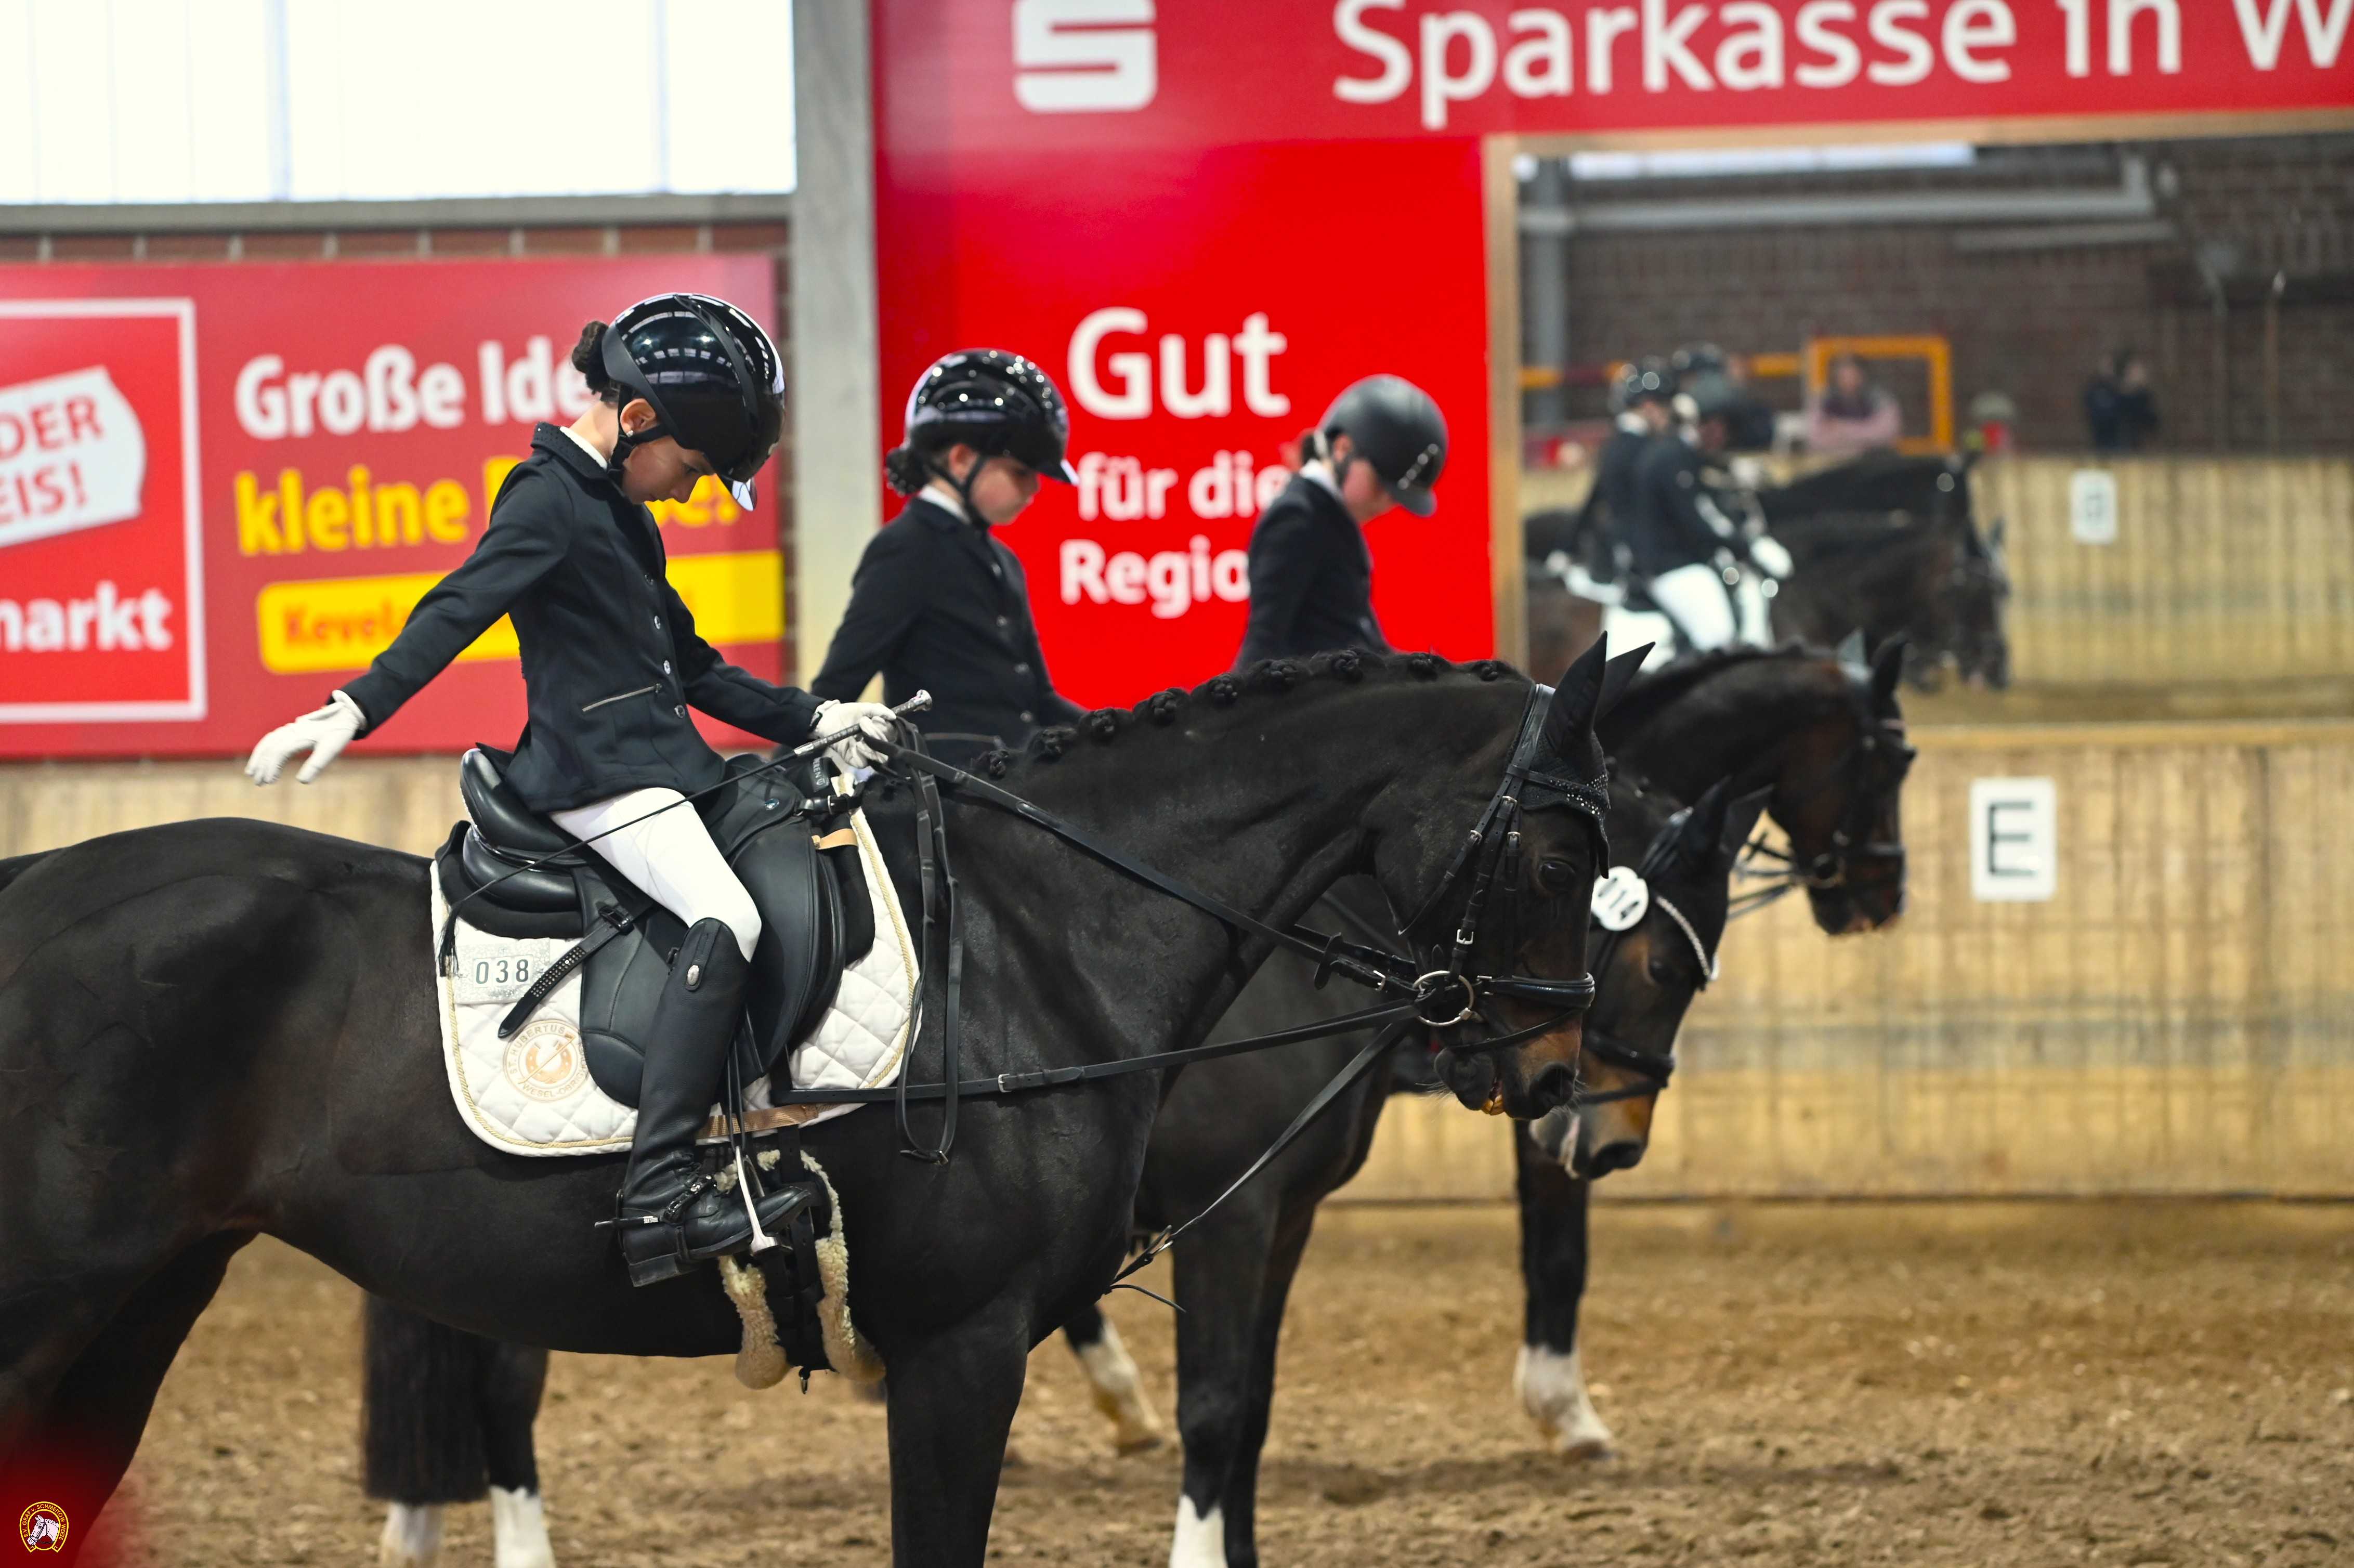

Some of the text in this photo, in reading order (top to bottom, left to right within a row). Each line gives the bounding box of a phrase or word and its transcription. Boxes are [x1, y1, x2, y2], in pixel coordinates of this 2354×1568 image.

[1332, 0, 2018, 130] Sparkasse
[2056, 0, 2182, 77] in
[233, 335, 597, 440] Große Ide
[1067, 306, 1291, 420] Gut
[233, 464, 470, 556] kleine
[1077, 452, 1178, 521] für
[1060, 534, 1251, 619] Regio
[1987, 800, 2037, 877] E
[476, 959, 529, 984] 038
[511, 1025, 566, 1056] HUBERTUS
